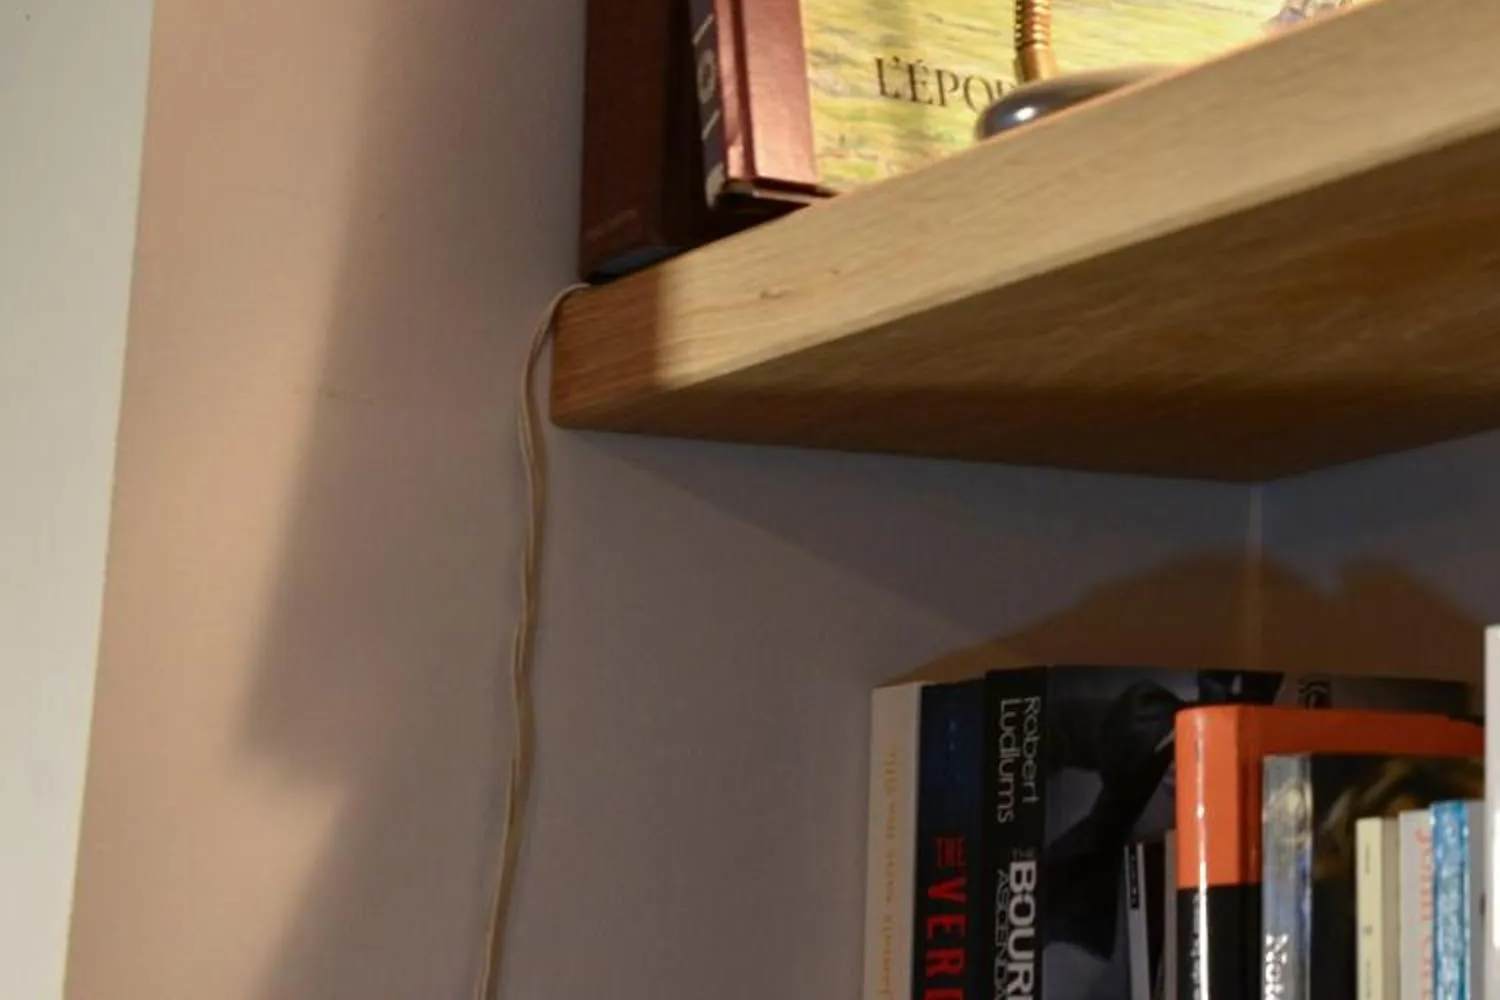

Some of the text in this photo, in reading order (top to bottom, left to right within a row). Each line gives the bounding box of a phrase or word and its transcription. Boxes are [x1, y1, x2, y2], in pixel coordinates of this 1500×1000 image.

[1021, 695, 1041, 804] Robert
[1007, 860, 1037, 1000] BOUR
[1264, 932, 1290, 1000] Not
